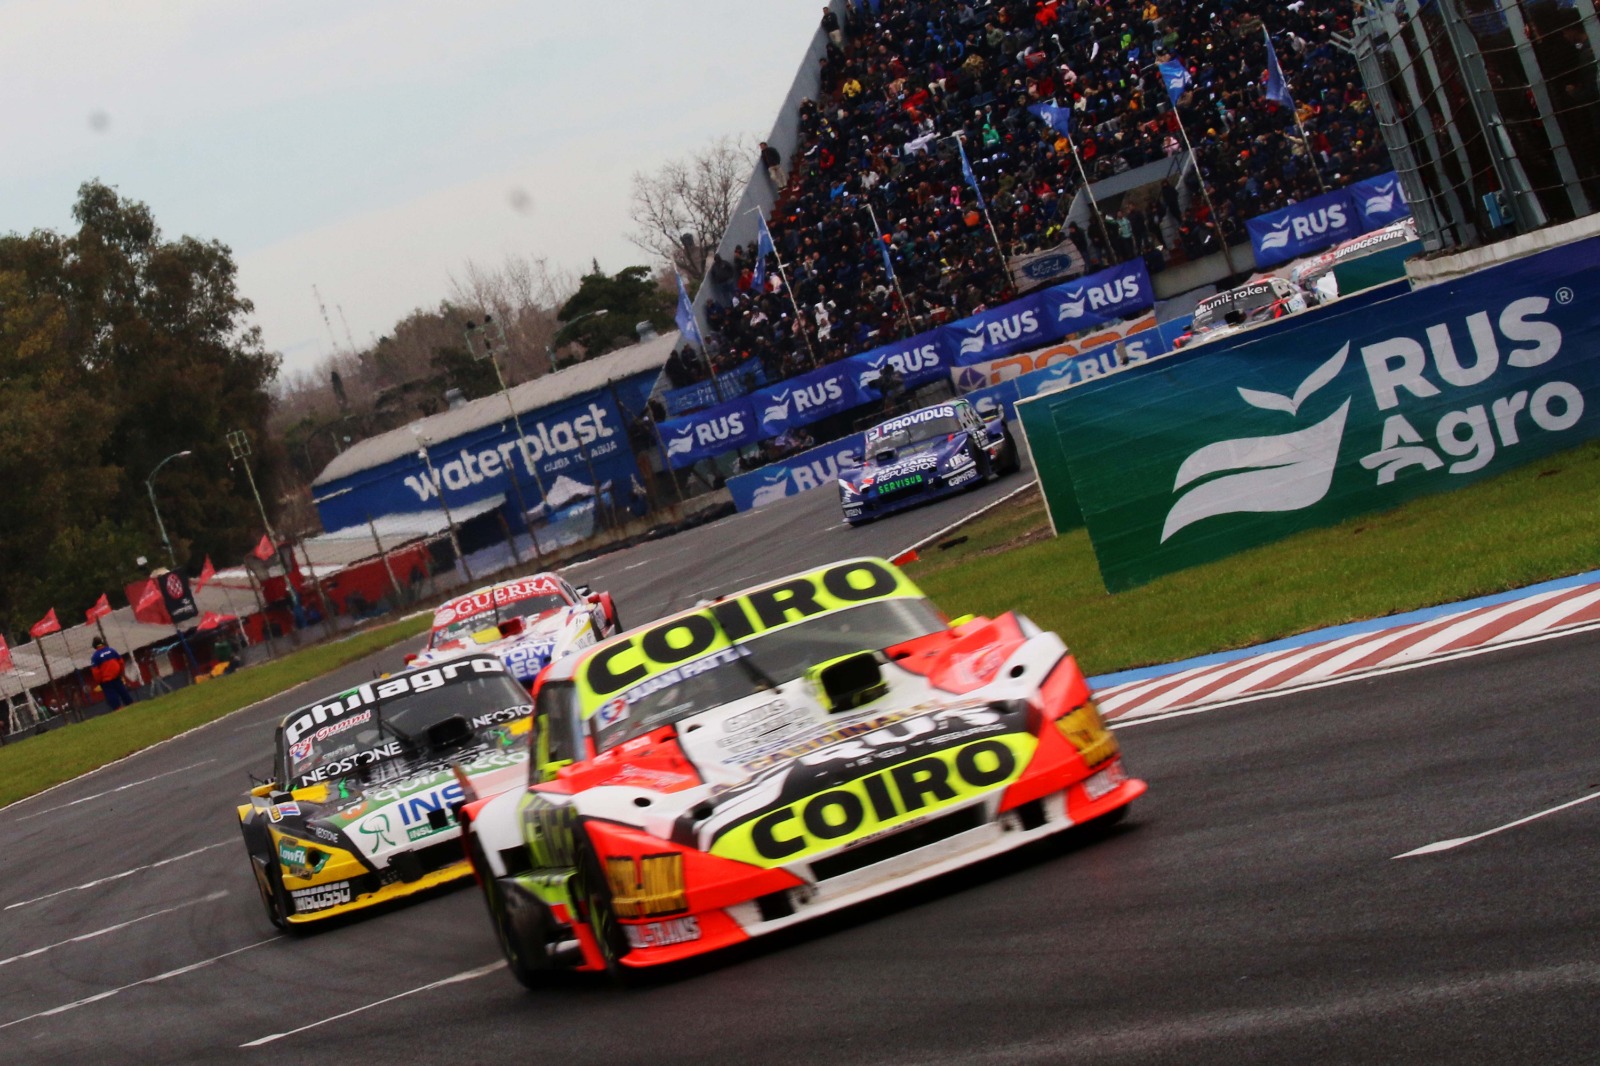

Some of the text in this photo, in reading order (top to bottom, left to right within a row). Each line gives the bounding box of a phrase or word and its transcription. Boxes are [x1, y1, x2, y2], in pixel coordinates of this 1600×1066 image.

[1292, 204, 1346, 240] RUS
[1087, 275, 1140, 310] RUS
[987, 310, 1039, 345] RUS
[1077, 341, 1148, 381] RUS
[792, 377, 843, 413] RUS
[696, 412, 745, 446] RUS
[883, 406, 955, 435] PROVIDUS
[1360, 381, 1584, 486] Agro
[404, 404, 613, 502] waterplast
[791, 449, 860, 493] RUS
[876, 461, 938, 485] REPUESTOS
[878, 474, 923, 495] SERVISUB
[455, 578, 559, 616] GUERRA
[587, 560, 898, 696] COIRO
[285, 659, 504, 745] philagro
[289, 735, 315, 757] Der
[315, 709, 372, 740] Gummi
[301, 741, 403, 788] NEOSTONE
[751, 740, 1016, 859] COIRO
